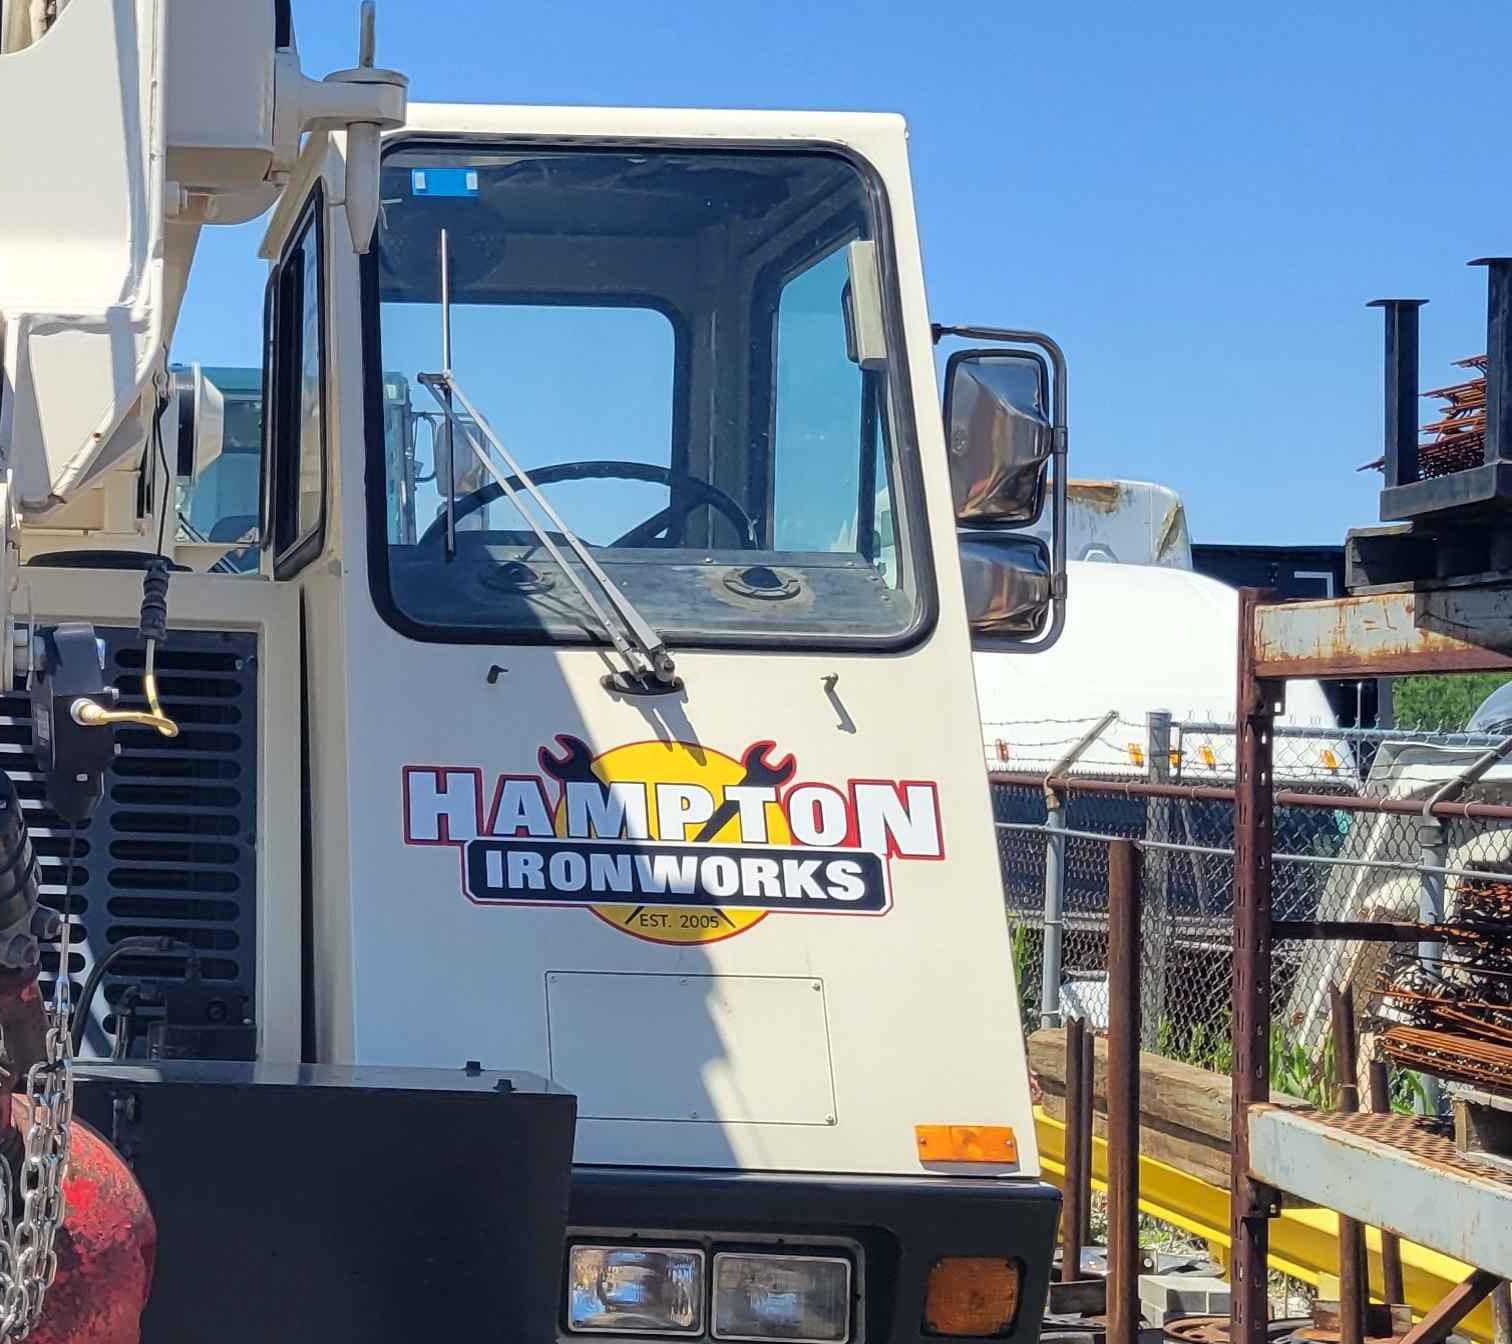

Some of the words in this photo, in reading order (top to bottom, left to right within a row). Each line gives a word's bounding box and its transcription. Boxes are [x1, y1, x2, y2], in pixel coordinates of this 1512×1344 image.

[404, 766, 943, 859] HAMPTON
[485, 850, 866, 901] IRONWORKS
[639, 913, 672, 928] EST.
[679, 914, 720, 929] 2005
